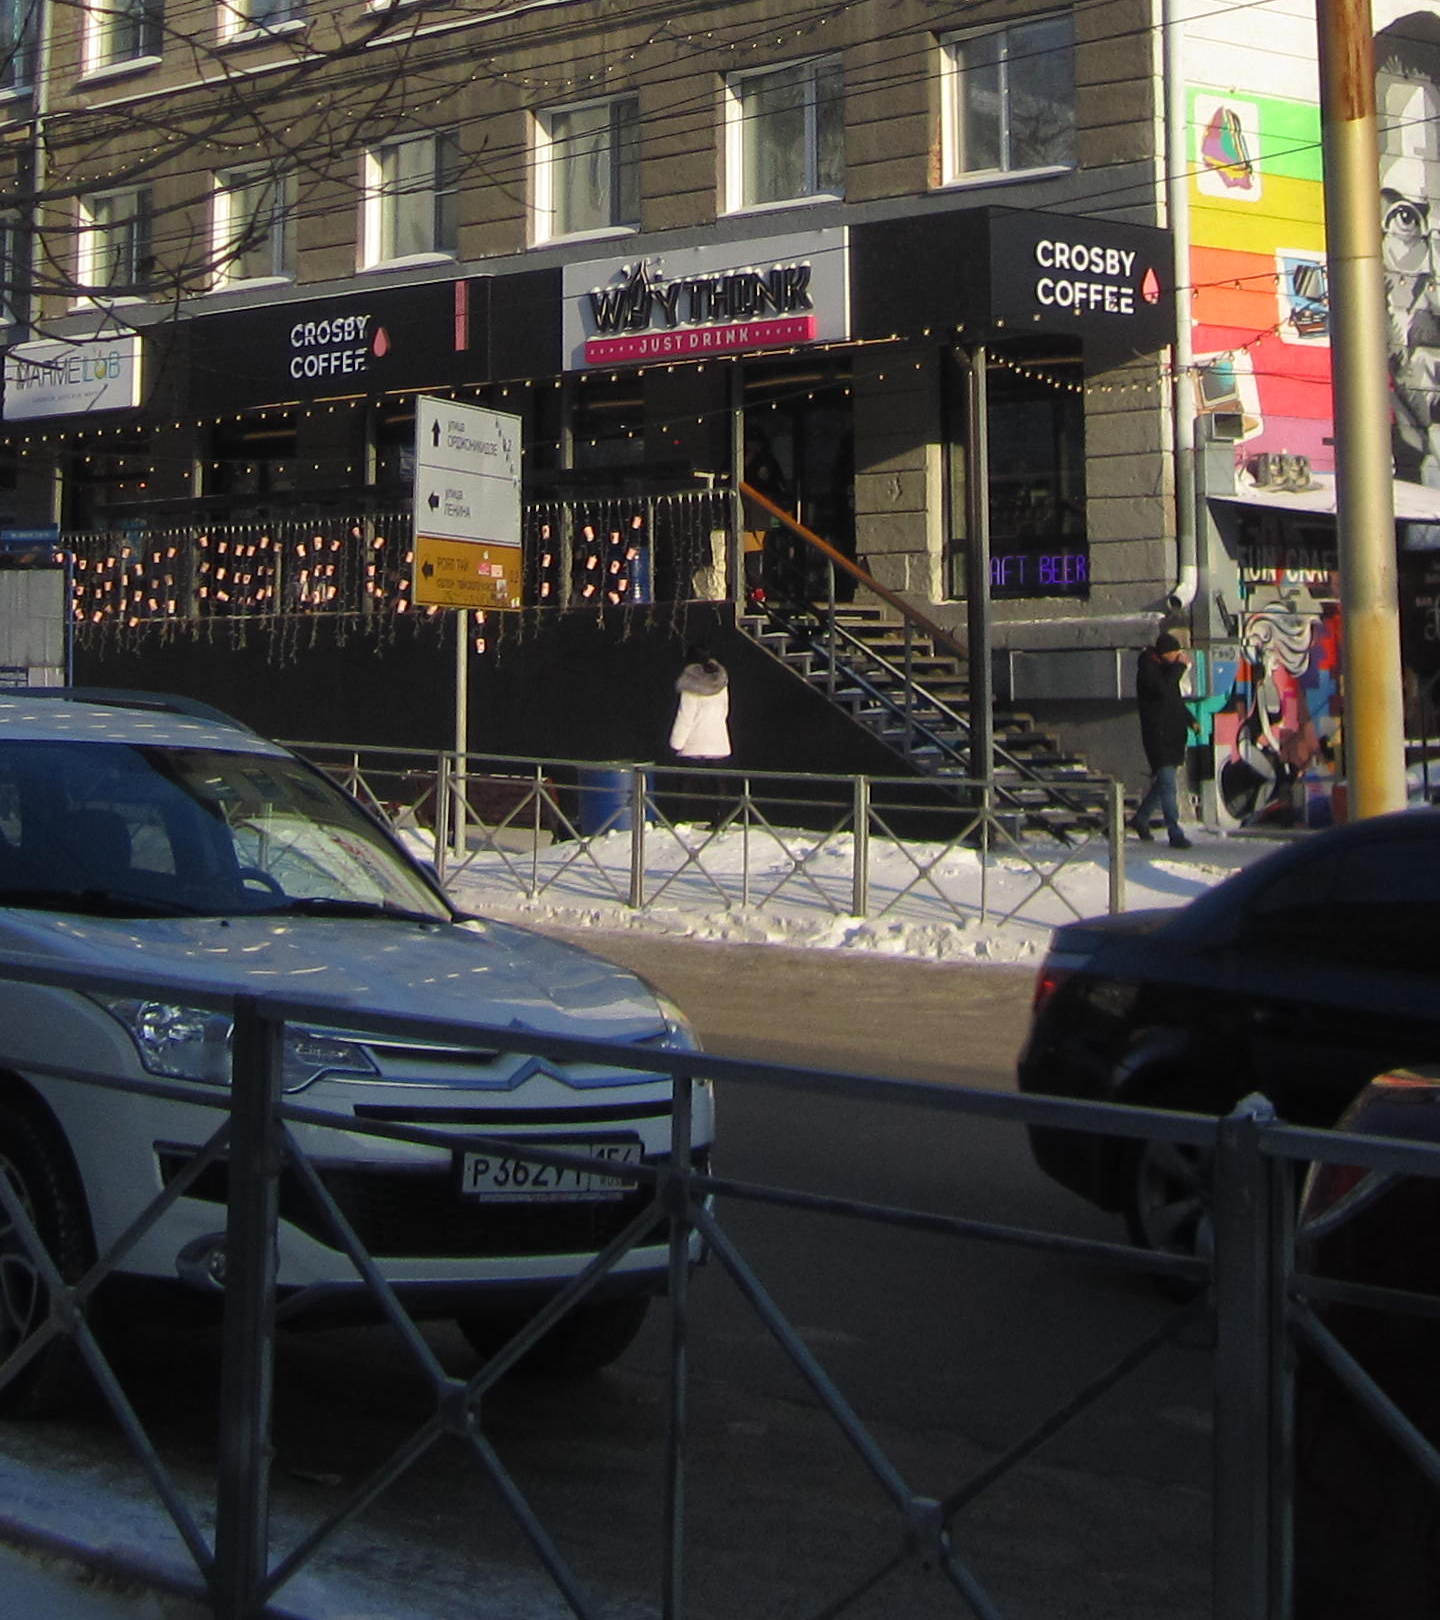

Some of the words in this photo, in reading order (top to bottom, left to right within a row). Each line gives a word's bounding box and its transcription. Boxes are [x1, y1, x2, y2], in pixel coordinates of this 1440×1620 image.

[1035, 239, 1137, 277] CROSBY
[1036, 277, 1135, 315] COFFEE
[290, 314, 371, 348] CROSBY
[639, 335, 683, 354] JUST
[689, 326, 750, 347] DRINK
[290, 347, 368, 379] COFFEE
[1040, 555, 1086, 585] BEER
